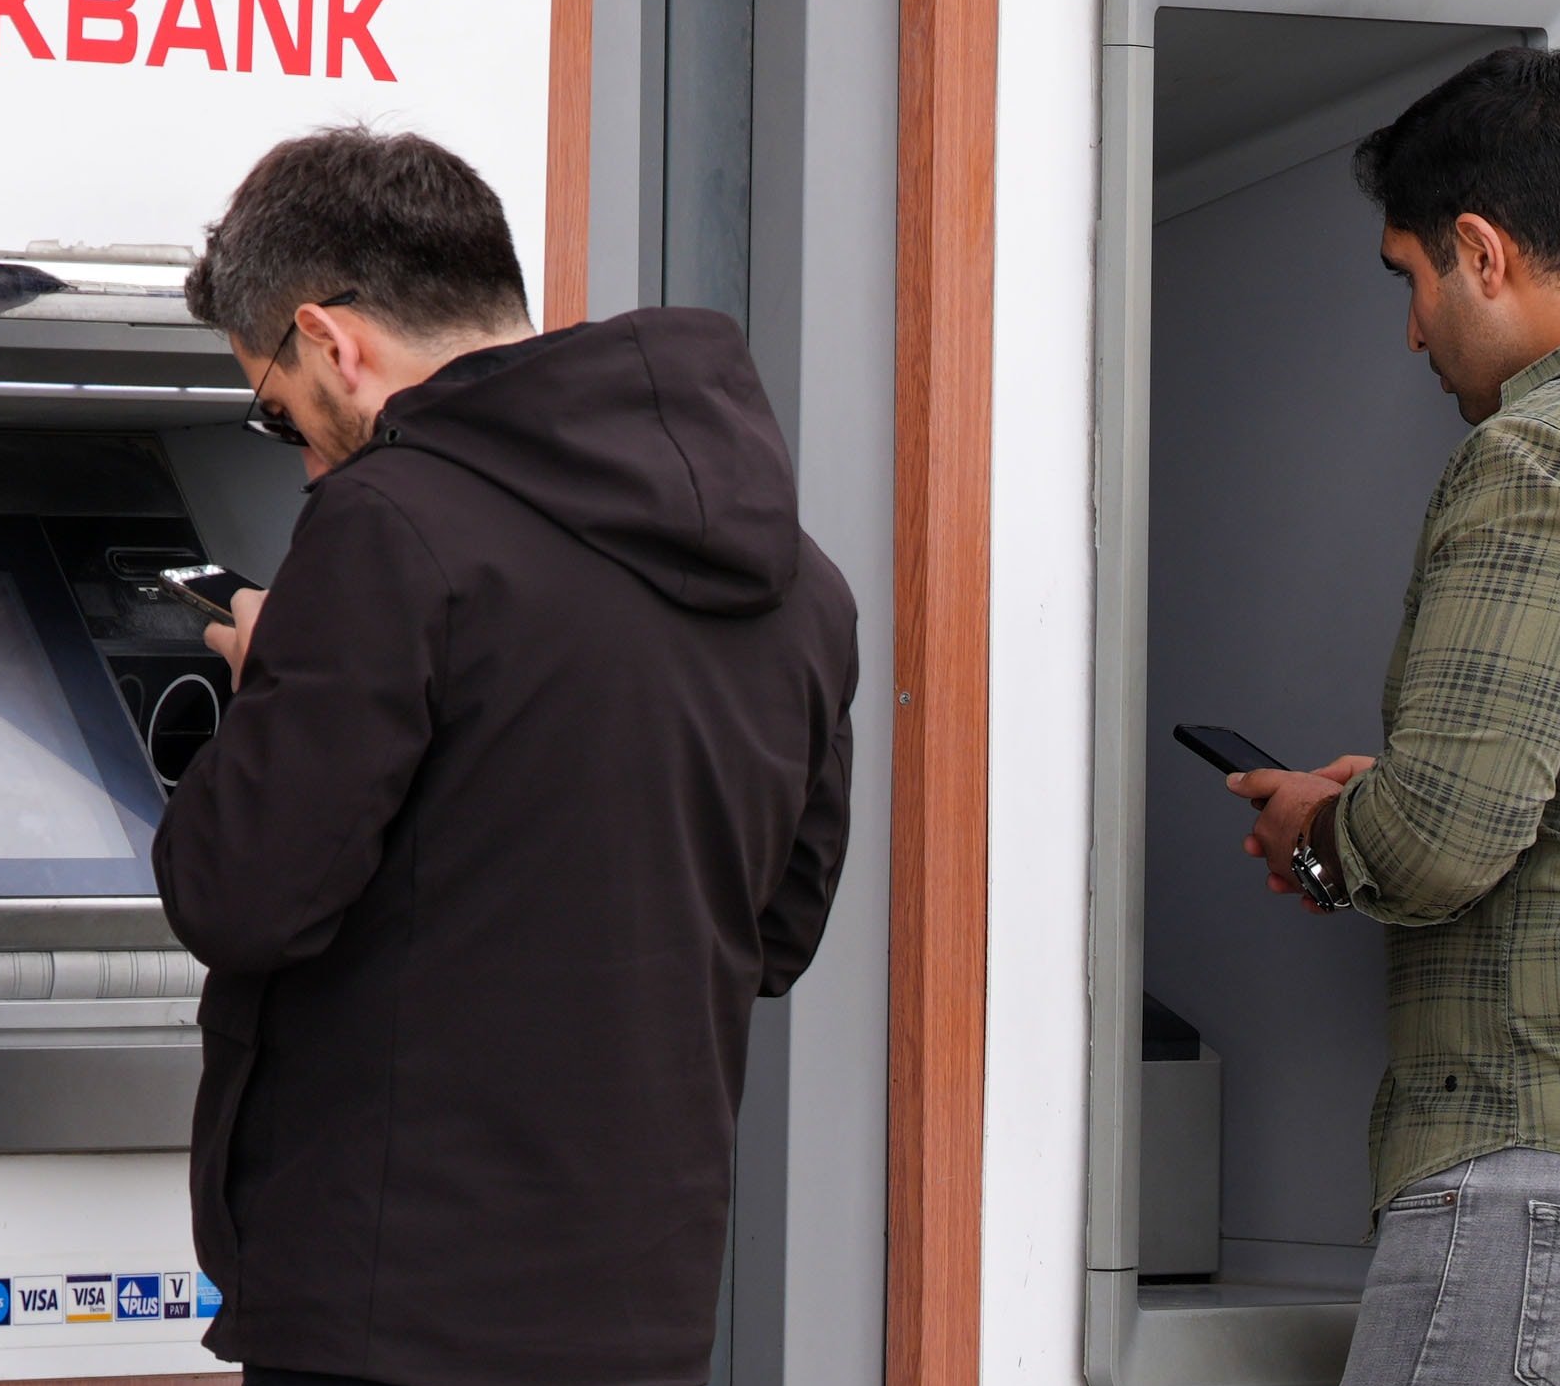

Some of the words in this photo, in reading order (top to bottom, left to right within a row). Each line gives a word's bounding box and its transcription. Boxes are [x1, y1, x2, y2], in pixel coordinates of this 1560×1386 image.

[72, 1287, 106, 1306] VISA
[169, 1279, 183, 1299] V
[18, 1289, 58, 1311] VISA
[128, 1296, 159, 1316] PLUS
[170, 1304, 185, 1316] PAY
